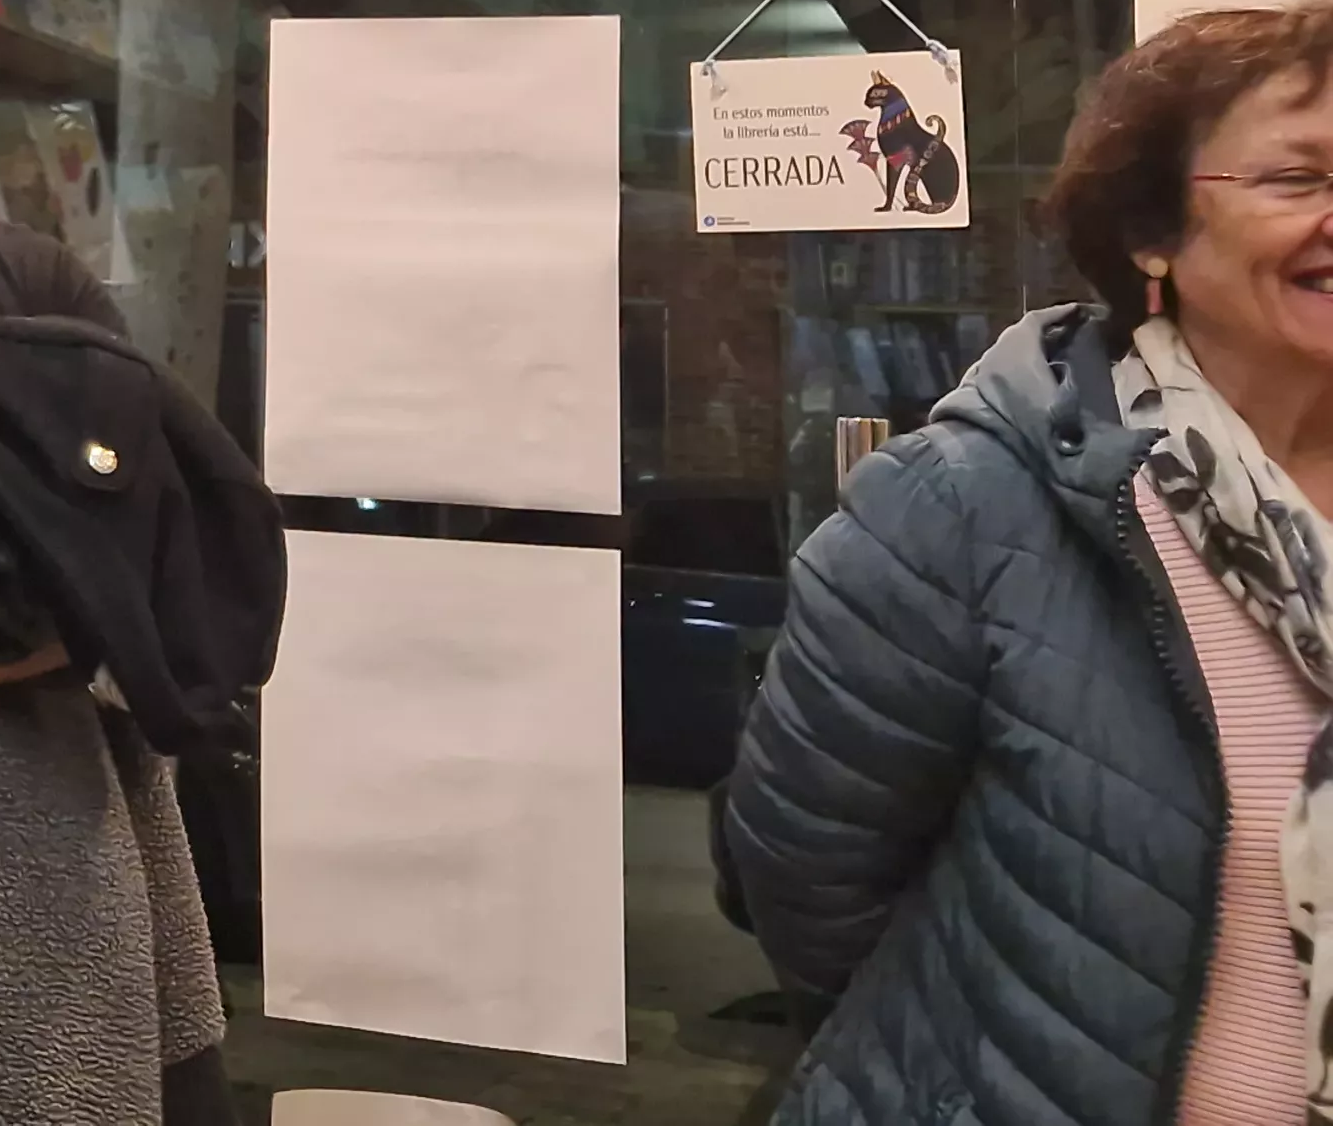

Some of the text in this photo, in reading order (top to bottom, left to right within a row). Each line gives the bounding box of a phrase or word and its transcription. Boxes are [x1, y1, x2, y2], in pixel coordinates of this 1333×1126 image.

[713, 105, 830, 120] En estos momentos
[723, 126, 734, 139] la
[737, 125, 780, 138] librería
[704, 155, 845, 189] CERRADA
